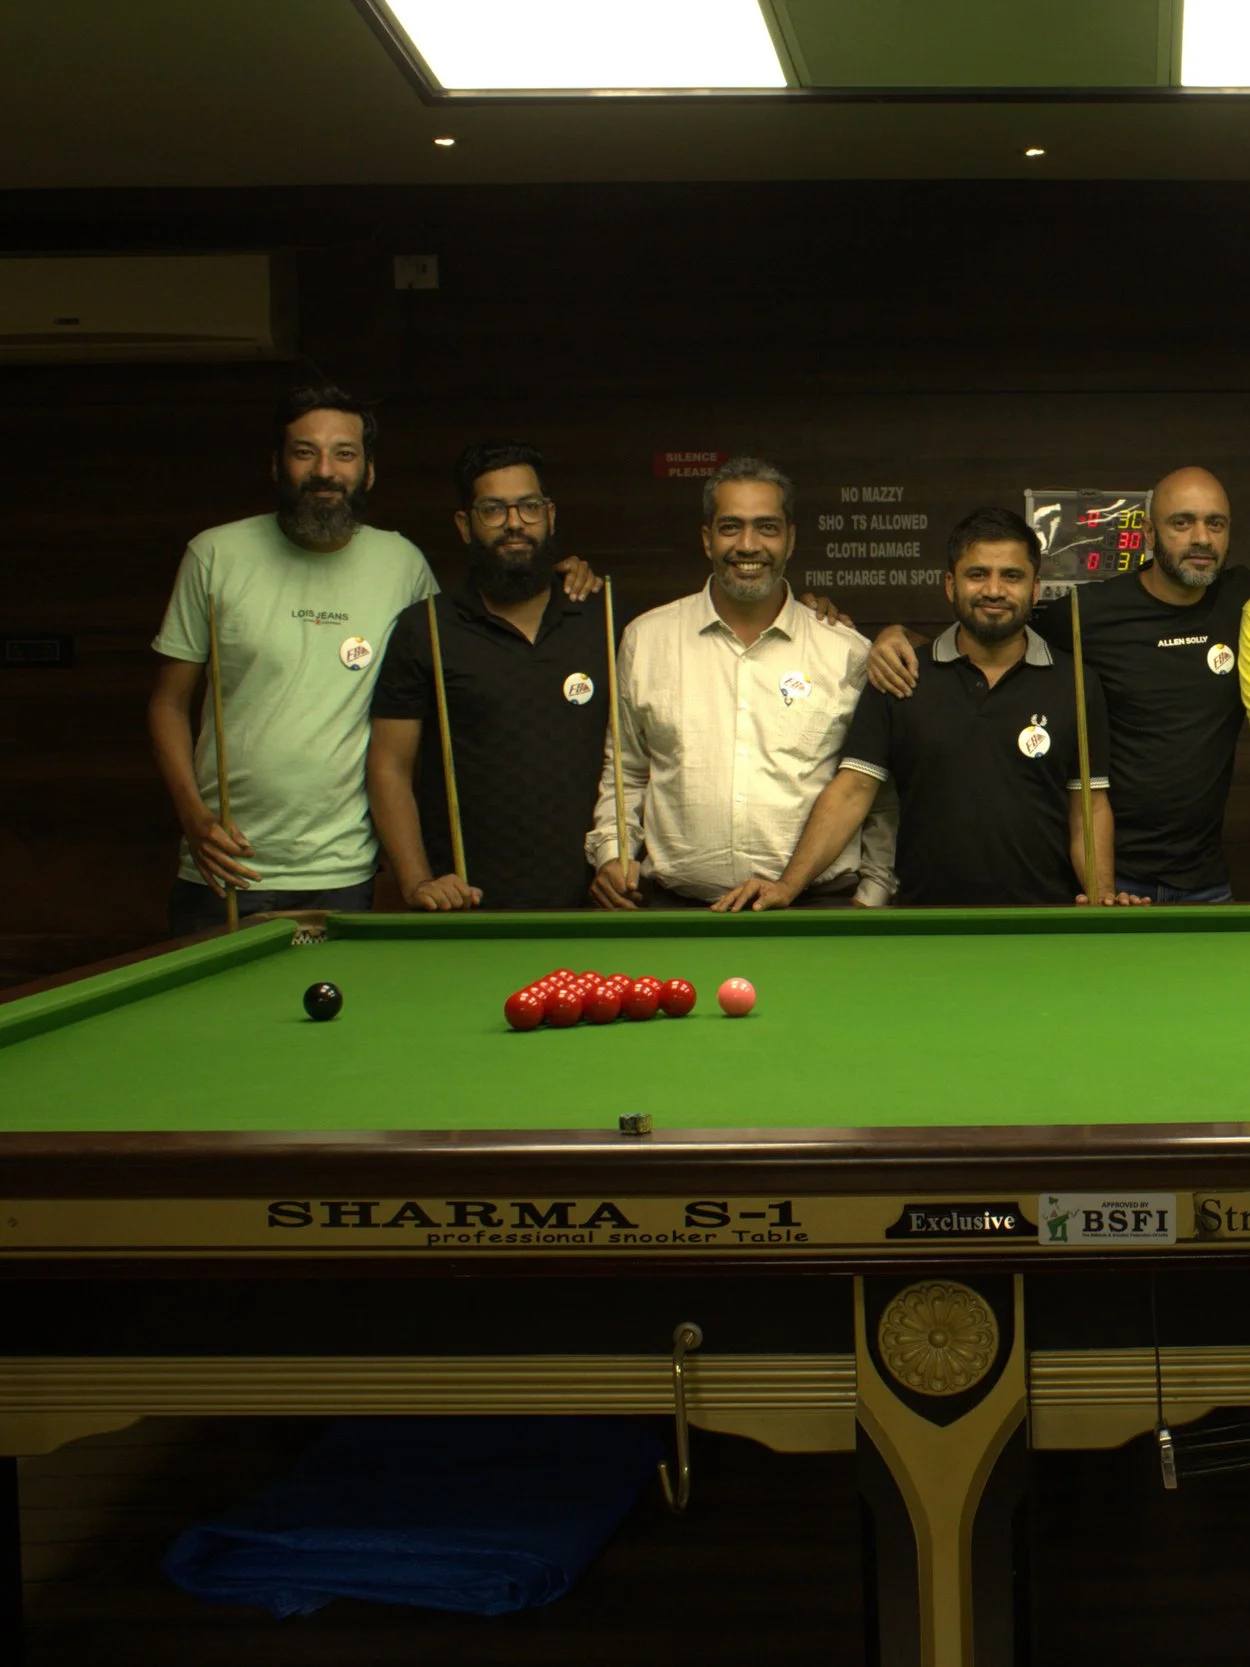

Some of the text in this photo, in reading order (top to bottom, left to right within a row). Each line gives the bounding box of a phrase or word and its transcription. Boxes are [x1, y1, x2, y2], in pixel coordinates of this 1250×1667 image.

[666, 452, 718, 462] SILENCE
[668, 467, 715, 477] PLEASE
[841, 486, 904, 502] NO MAZZY
[870, 513, 928, 530] ALLOWED
[1117, 531, 1142, 549] 30
[826, 541, 921, 558] CLOTH DAMAGE
[1087, 552, 1100, 570] 0
[805, 570, 942, 586] FINE CHARGE ON SPOT
[291, 610, 349, 621] LOIS JEANS
[1157, 635, 1208, 648] ALLEN SOLLY
[268, 1200, 802, 1229] SHARMA S-1
[908, 1210, 1016, 1232] Exclusive
[1082, 1210, 1168, 1232] BSFI
[427, 1229, 809, 1247] professional snooker Table
